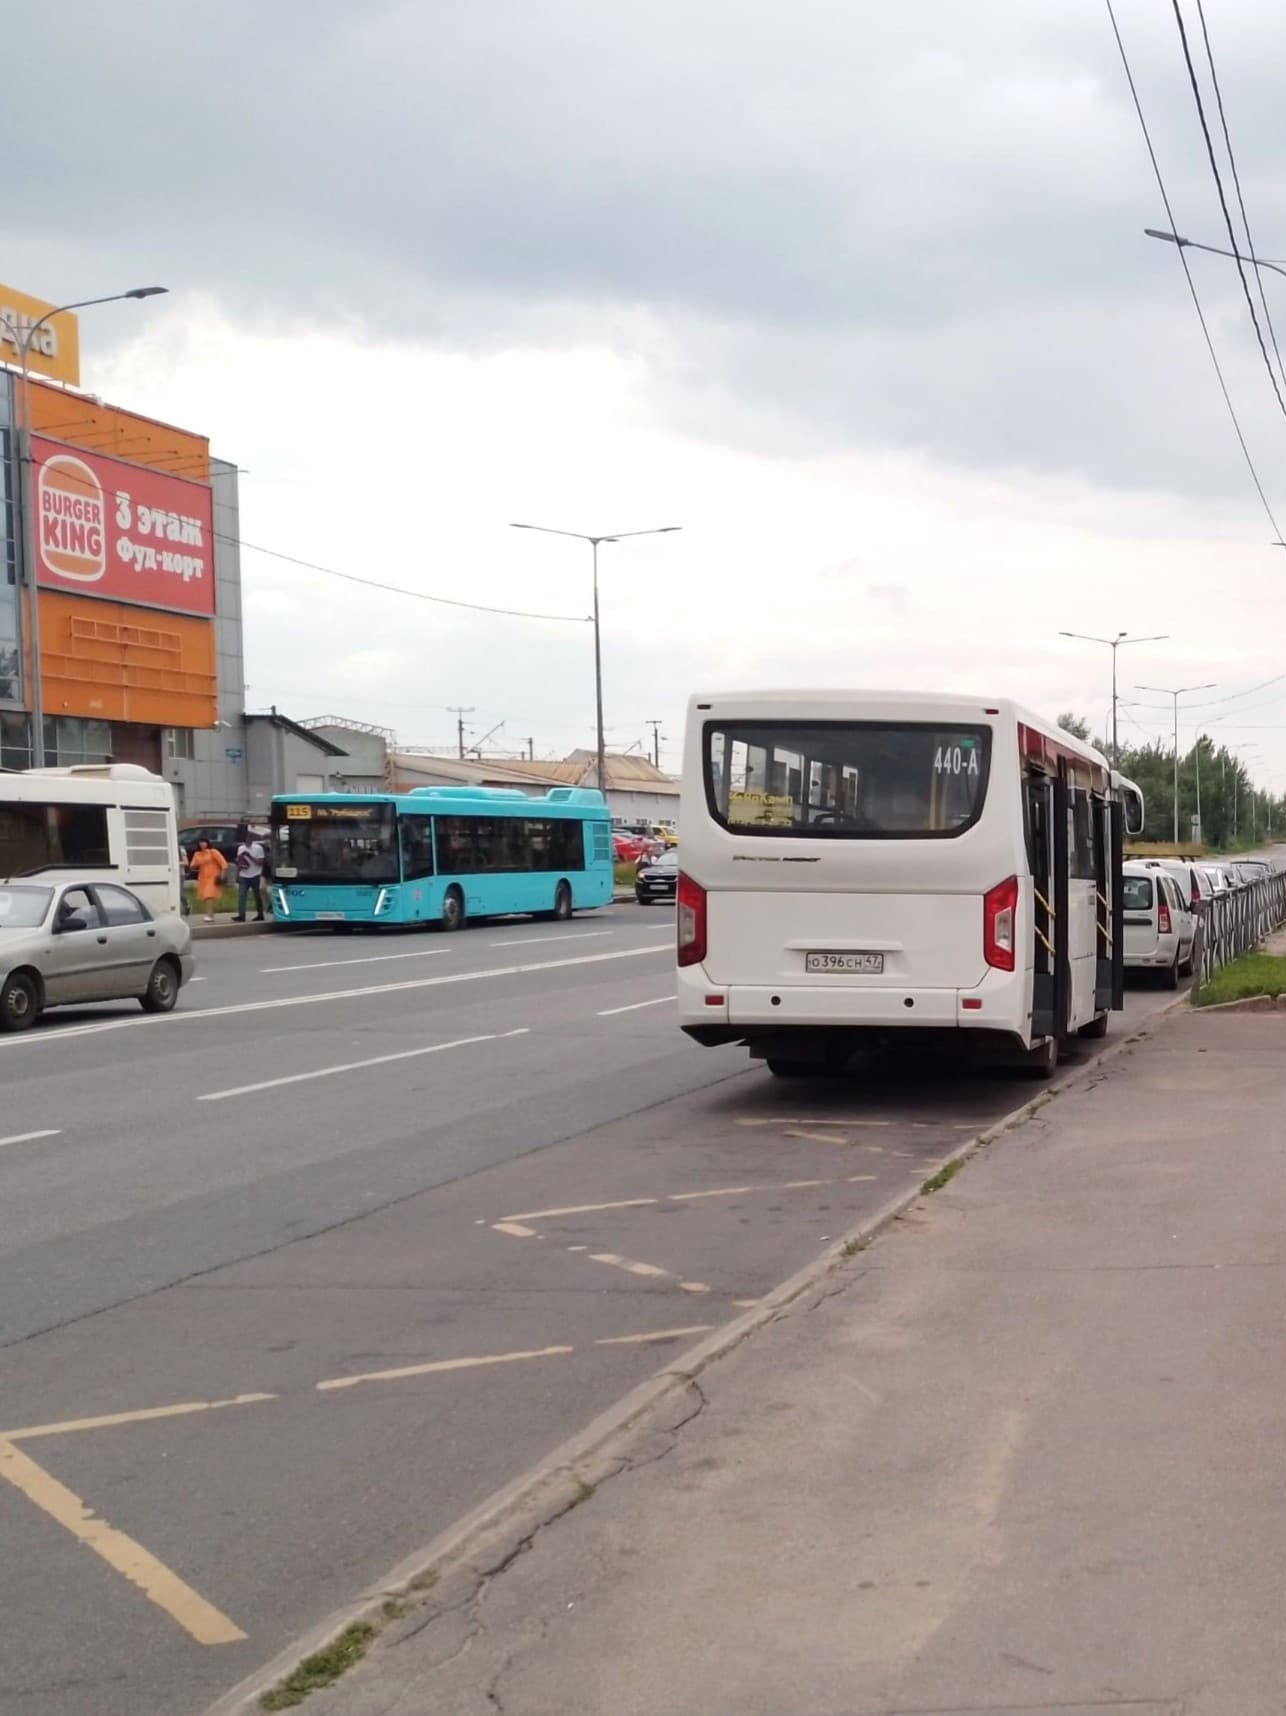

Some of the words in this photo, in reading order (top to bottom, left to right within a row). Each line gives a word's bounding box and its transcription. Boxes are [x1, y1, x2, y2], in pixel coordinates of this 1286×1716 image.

[42, 490, 101, 525] BURGER
[116, 491, 132, 530] 3
[137, 505, 204, 547] этаж
[43, 515, 103, 557] KING
[116, 536, 204, 582] Фуд-корт
